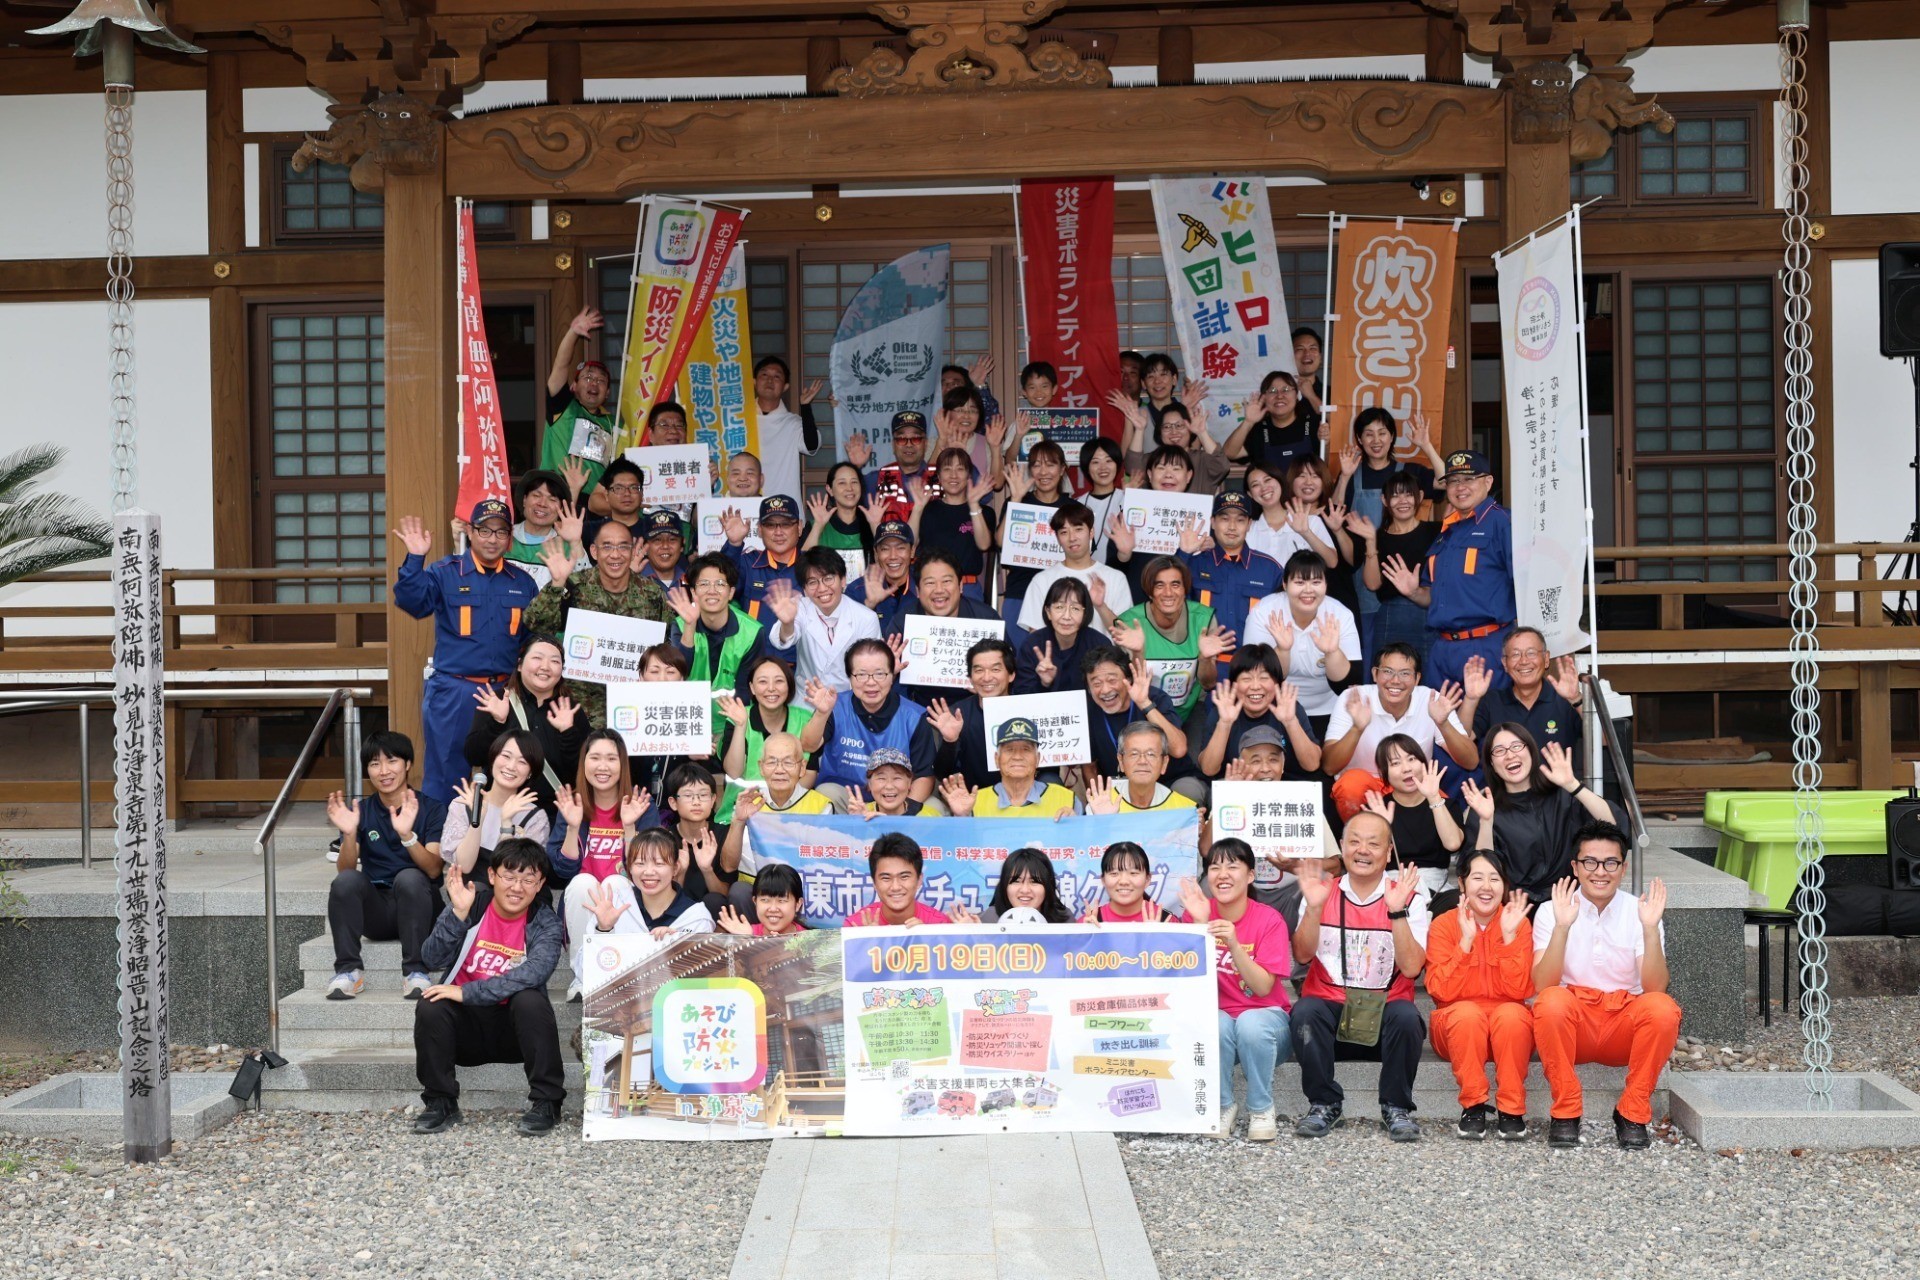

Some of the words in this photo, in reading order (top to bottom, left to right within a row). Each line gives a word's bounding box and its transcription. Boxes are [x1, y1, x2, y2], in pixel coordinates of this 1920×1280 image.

[892, 342, 918, 354] Oita
[658, 460, 702, 476] 避難者
[1161, 661, 1193, 670] スタッフ
[644, 706, 704, 720] 災害保険
[644, 722, 704, 736] の必要性
[840, 735, 865, 749] OPDO
[1252, 802, 1316, 818] 非常無線
[1252, 822, 1316, 838] 通信訓練
[867, 943, 1046, 974] 10月19日(日)
[1076, 997, 1159, 1013] 防災倉庫備品体験
[680, 1003, 737, 1024] あそび
[1089, 1019, 1145, 1031] ロープワーク
[682, 1026, 738, 1055] 防災
[1100, 1038, 1159, 1051] 炊き出し訓練
[1193, 1041, 1206, 1067] 主催
[682, 1056, 740, 1072] プロジェクト
[1105, 1058, 1135, 1067] ミニ災害
[1084, 1066, 1156, 1076] ボランティアセンター
[1195, 1078, 1208, 1116] 浄泉寺
[675, 1096, 695, 1117] in
[701, 1093, 764, 1119] 浄泉寺
